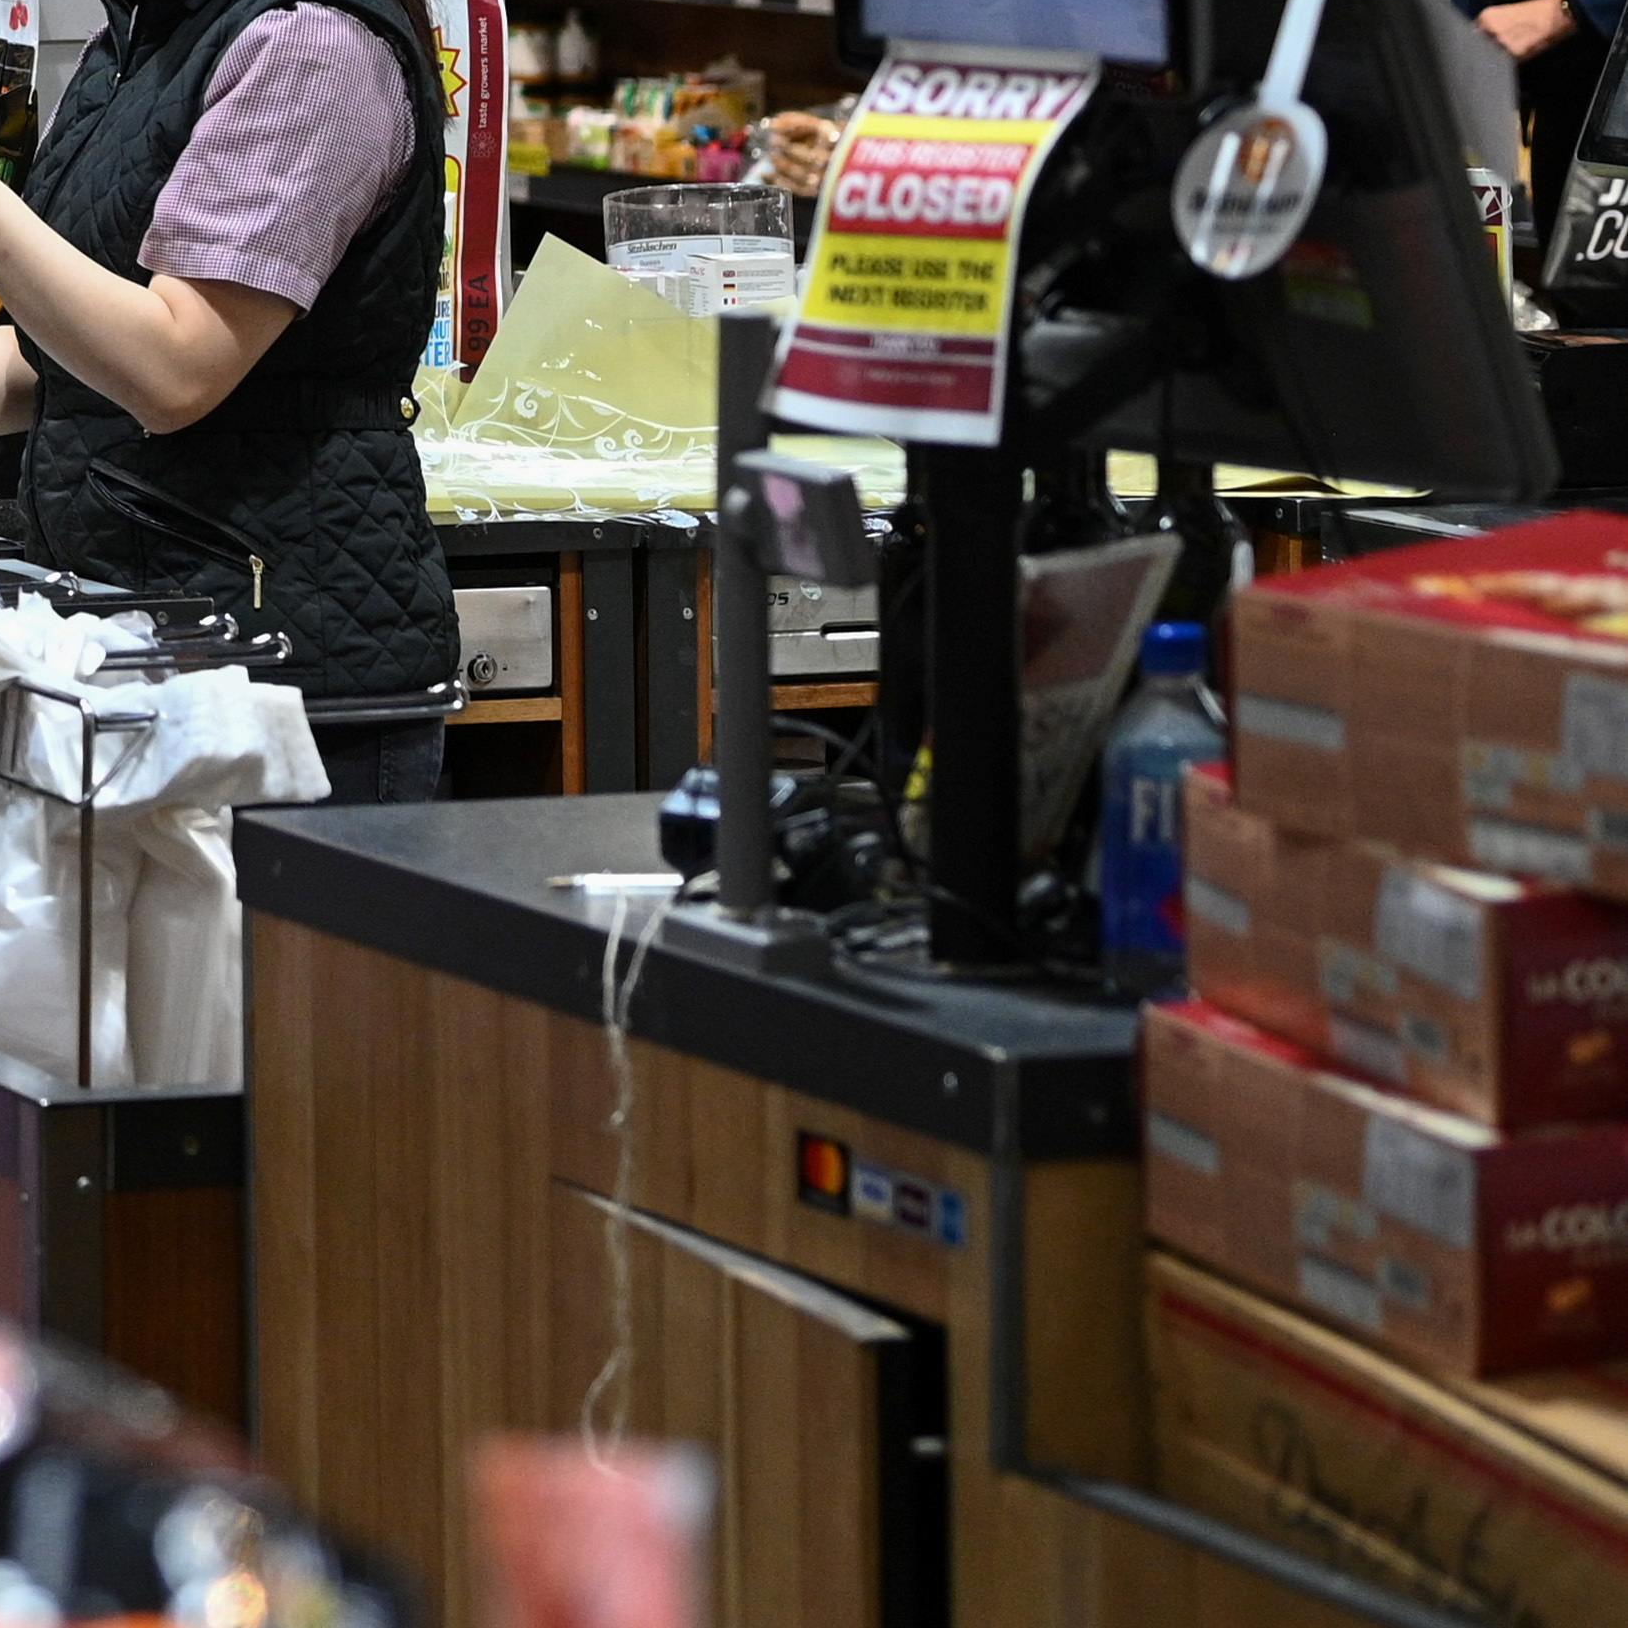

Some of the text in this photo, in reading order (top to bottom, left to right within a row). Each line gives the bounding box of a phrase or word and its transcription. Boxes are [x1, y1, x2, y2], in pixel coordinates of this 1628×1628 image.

[478, 17, 490, 129] taste growers market
[876, 65, 1078, 121] SORRY
[834, 171, 1014, 223] CLOSED
[829, 252, 903, 277] PLEASE
[467, 274, 491, 309] EA
[828, 282, 886, 307] NEXT
[425, 340, 452, 367] TER
